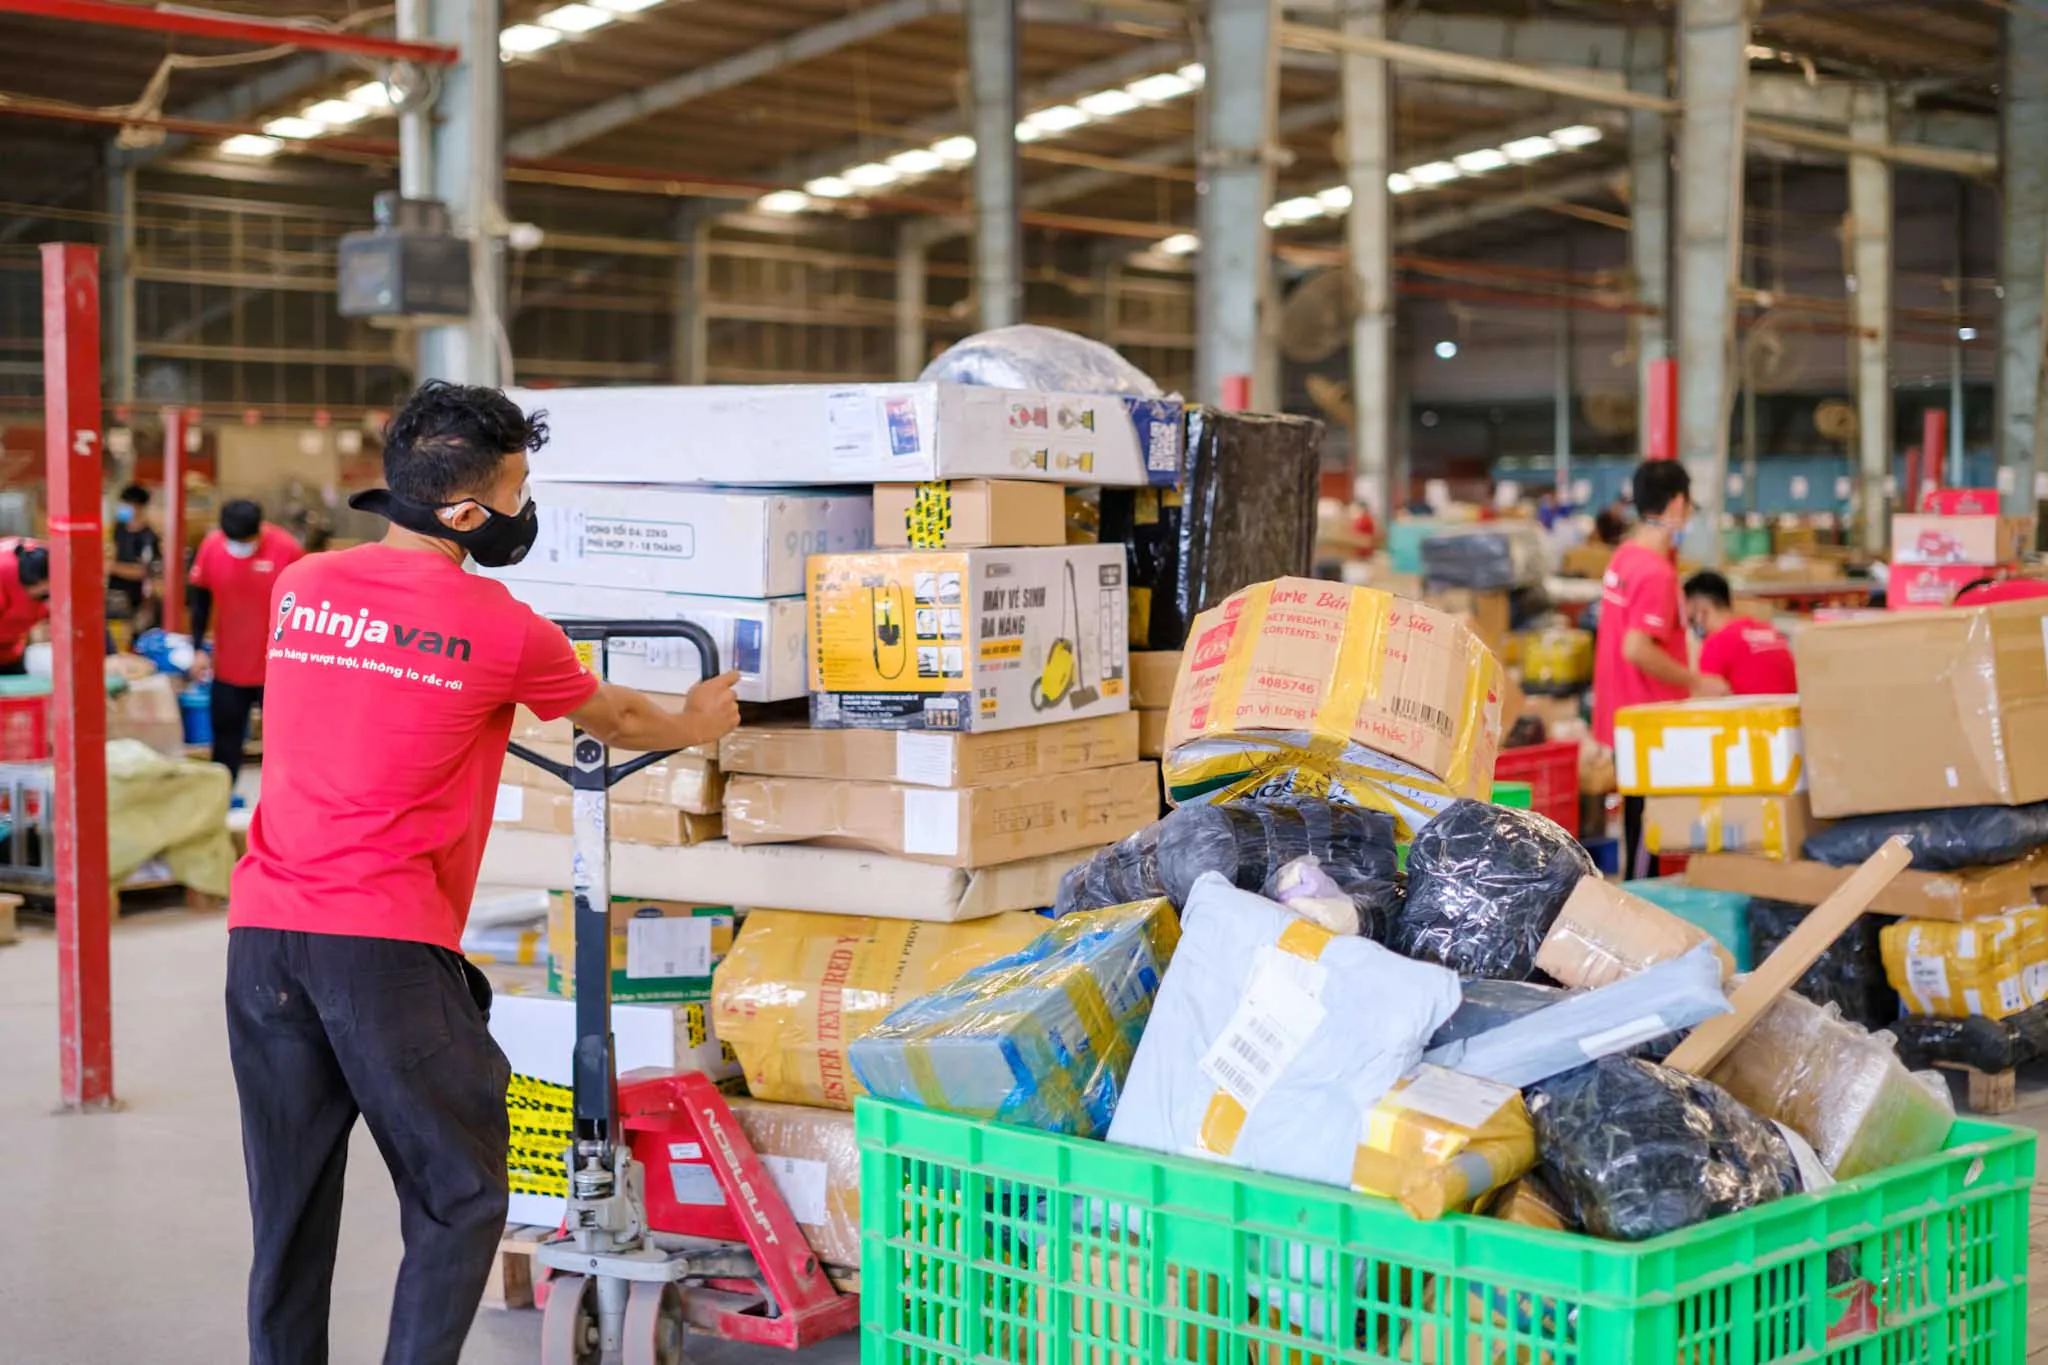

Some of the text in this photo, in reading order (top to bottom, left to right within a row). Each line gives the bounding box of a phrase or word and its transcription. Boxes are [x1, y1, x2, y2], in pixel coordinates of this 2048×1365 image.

[1022, 586, 1046, 609] SINH
[1263, 624, 1320, 641] CONTENTS:
[362, 658, 402, 679] không
[406, 667, 420, 681] lo
[1258, 676, 1315, 694] 4085746
[817, 950, 854, 1041] TEXTURED
[702, 1107, 780, 1246] NOBLELIFT
